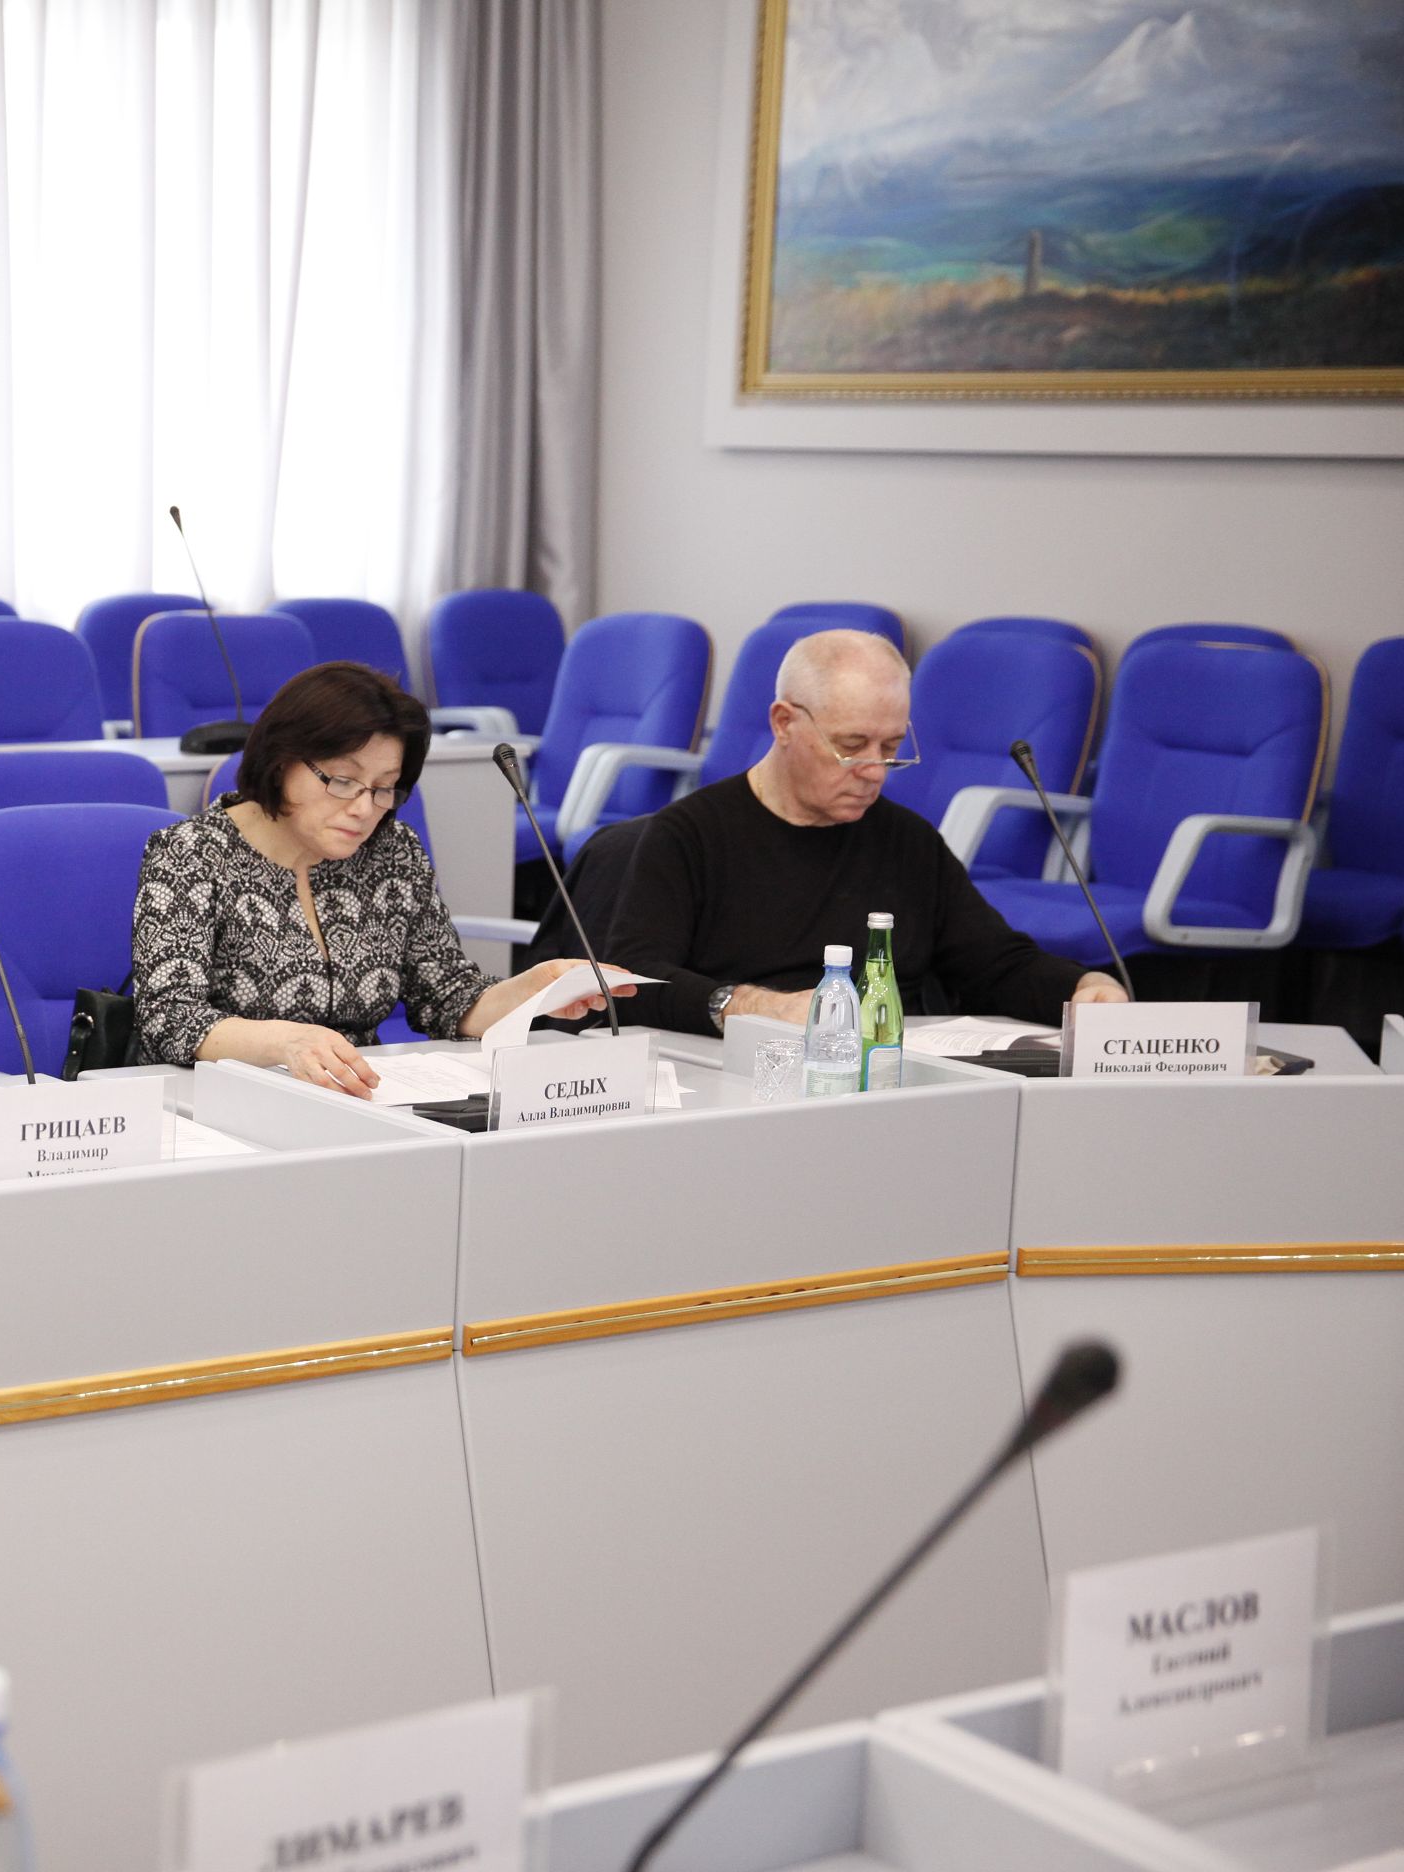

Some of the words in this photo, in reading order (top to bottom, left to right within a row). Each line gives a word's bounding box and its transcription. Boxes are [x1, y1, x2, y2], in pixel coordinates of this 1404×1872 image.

[1103, 1038, 1220, 1057] СТАЦЕНКО
[1093, 1061, 1151, 1073] Николай
[1155, 1061, 1228, 1075] Федорович
[544, 1077, 608, 1101] СЕДЫХ
[517, 1110, 546, 1123] Алла
[549, 1100, 631, 1120] Владимировна
[20, 1116, 126, 1142] ГРИЦАЕВ
[37, 1146, 109, 1163] Владимир
[1126, 1591, 1259, 1645] МАСЛОВ
